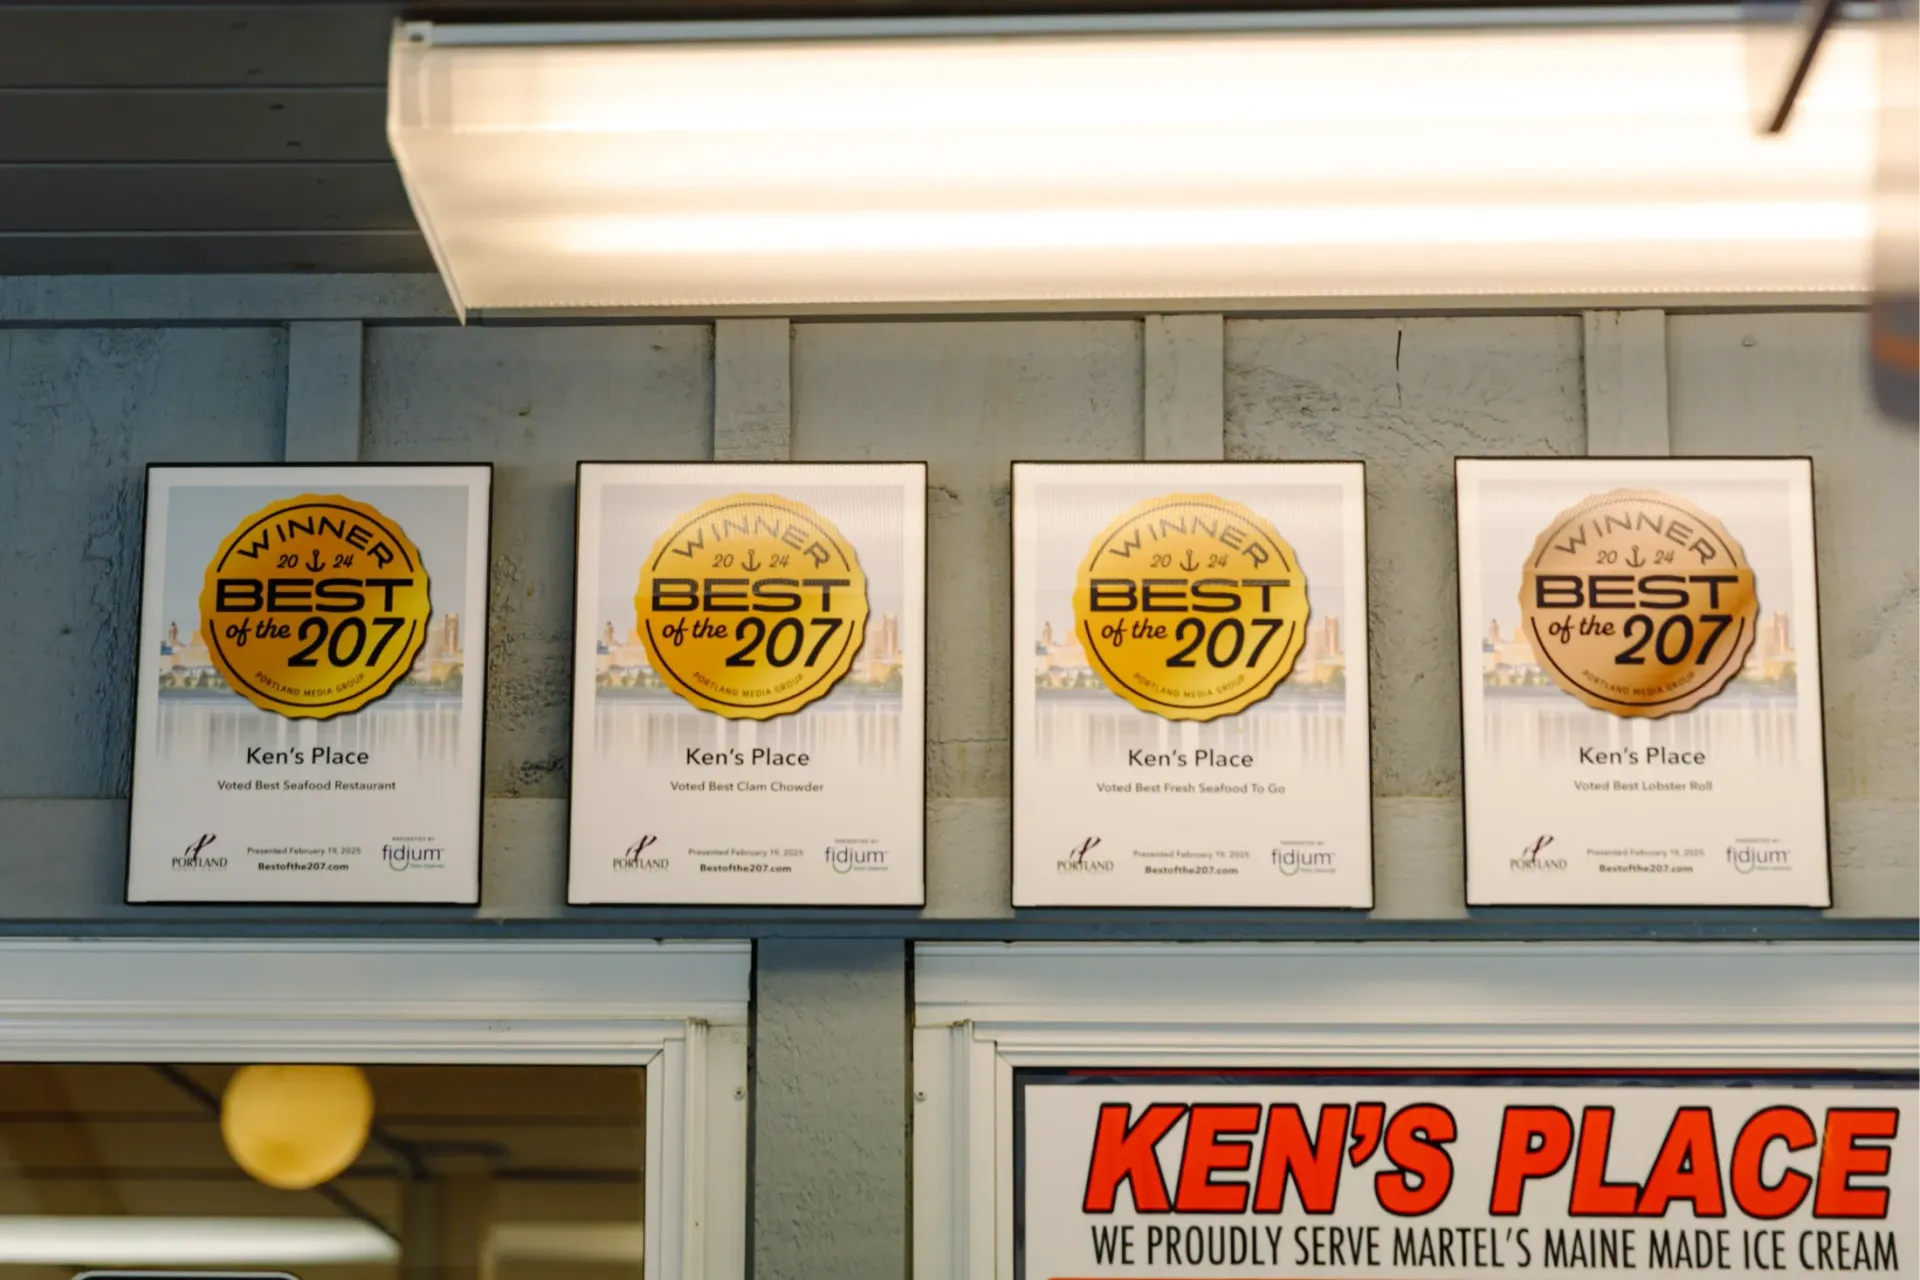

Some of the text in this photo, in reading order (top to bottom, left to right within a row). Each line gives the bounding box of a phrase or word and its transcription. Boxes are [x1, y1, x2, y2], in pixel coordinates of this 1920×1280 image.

[237, 516, 394, 570] WINNER
[672, 516, 831, 570] WINNER
[1109, 516, 1269, 569] WINNER
[1555, 512, 1717, 565] WINNER
[277, 554, 354, 568] 20 24
[712, 554, 790, 568] 20 24
[1150, 554, 1229, 568] 20 24
[1596, 550, 1675, 565] 20 24
[216, 578, 413, 613] BEST
[652, 578, 850, 613] BEST
[1090, 578, 1290, 613] BEST
[1536, 575, 1738, 609] BEST
[226, 617, 405, 668] of the 207
[662, 617, 843, 668] of the 207
[1100, 617, 1284, 668] of the 207
[1549, 614, 1733, 665] of the 207
[255, 671, 365, 697] PORTLAND MEDIA GROUP
[692, 671, 804, 698] PORTLAND MEDIA GROUP
[1133, 672, 1246, 699] PORTLAND MEDIA GROUP
[1582, 669, 1695, 696] PORTLAND MEDIA GROUP
[246, 747, 370, 765] Ken's Place
[686, 748, 810, 766] Ken's Place
[1128, 749, 1254, 768] Ken's Place
[1579, 746, 1706, 765] Ken's Place
[218, 780, 396, 790] Voted Best Seafood Restaurant
[670, 781, 824, 792] Voted Best Clam Chowder
[1096, 782, 1286, 794] Voted Best Fresh Seafood To Go
[1574, 780, 1712, 792] Voted Best Lobster Roll
[172, 857, 227, 868] PORTLAND
[258, 862, 349, 871] Bestofthe207.com
[613, 858, 668, 870] PORTLAND
[700, 864, 792, 873] Bestofthe207.com
[1057, 860, 1114, 872] PORTLAND
[1145, 866, 1238, 875] Bestofthe207.com
[1510, 858, 1567, 870] PORTLAND
[1600, 864, 1693, 873] Bestofthe207.com
[1082, 1101, 1899, 1220] KEN'S PLACE
[1092, 1225, 1899, 1271] WE PROUDLY SERVE MARTEL'S MAINE MADE ICE CREAM
